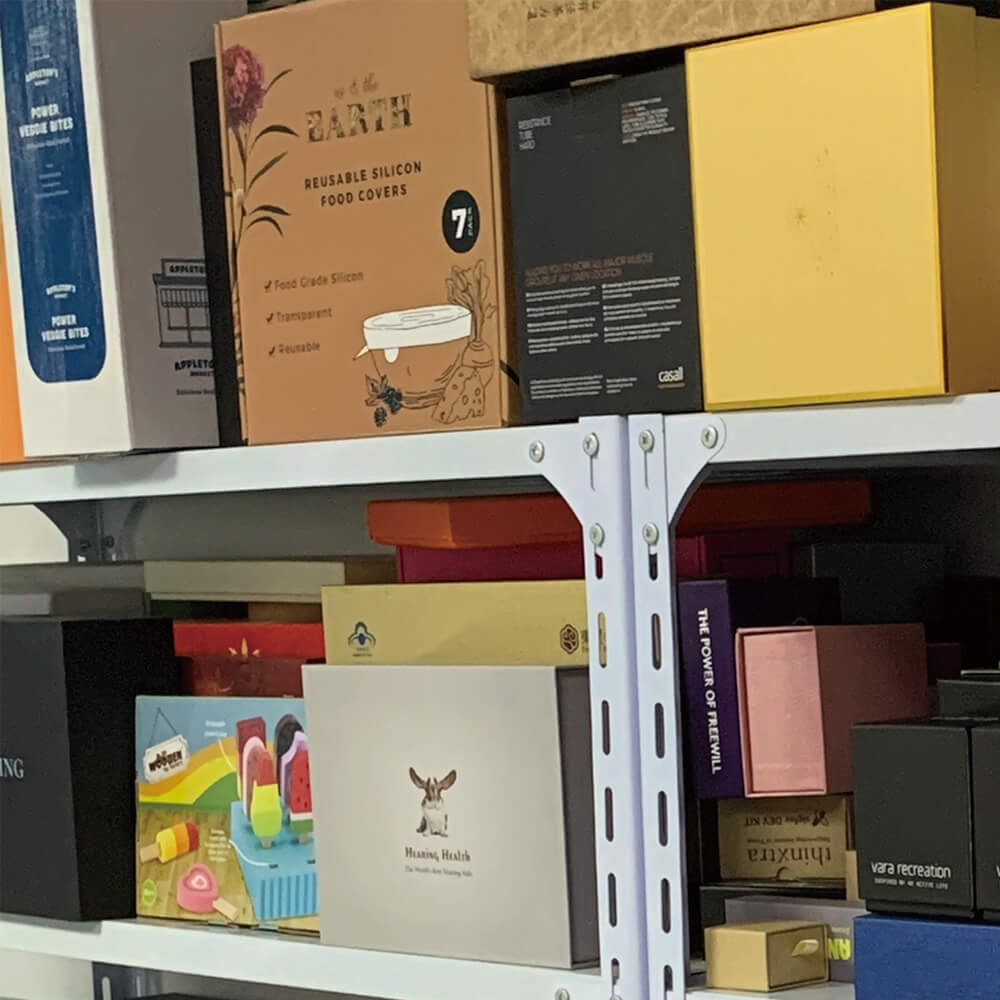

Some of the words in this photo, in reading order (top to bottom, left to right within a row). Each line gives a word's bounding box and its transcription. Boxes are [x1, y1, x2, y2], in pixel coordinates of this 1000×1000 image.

[31, 103, 60, 119] POWER
[305, 94, 412, 143] EARTH
[50, 117, 73, 133] BITES
[304, 169, 368, 191] REUSABLE
[372, 161, 422, 180] SILICON
[321, 191, 353, 207] FOOD
[359, 184, 408, 202] COVERS
[451, 208, 467, 239] 7
[274, 279, 297, 291] Food
[300, 276, 328, 288] Grade
[331, 271, 364, 284] Silicon
[51, 314, 77, 326] POWER
[276, 308, 333, 321] Transparent
[278, 342, 320, 354] Reusable
[697, 608, 710, 634] THE
[700, 637, 715, 687] POWER
[705, 690, 717, 709] OF
[707, 711, 722, 775] FREEWILL
[762, 815, 783, 826] DEV
[748, 847, 832, 866] thinxtra
[871, 861, 895, 875] vara
[897, 864, 951, 879] recreation
